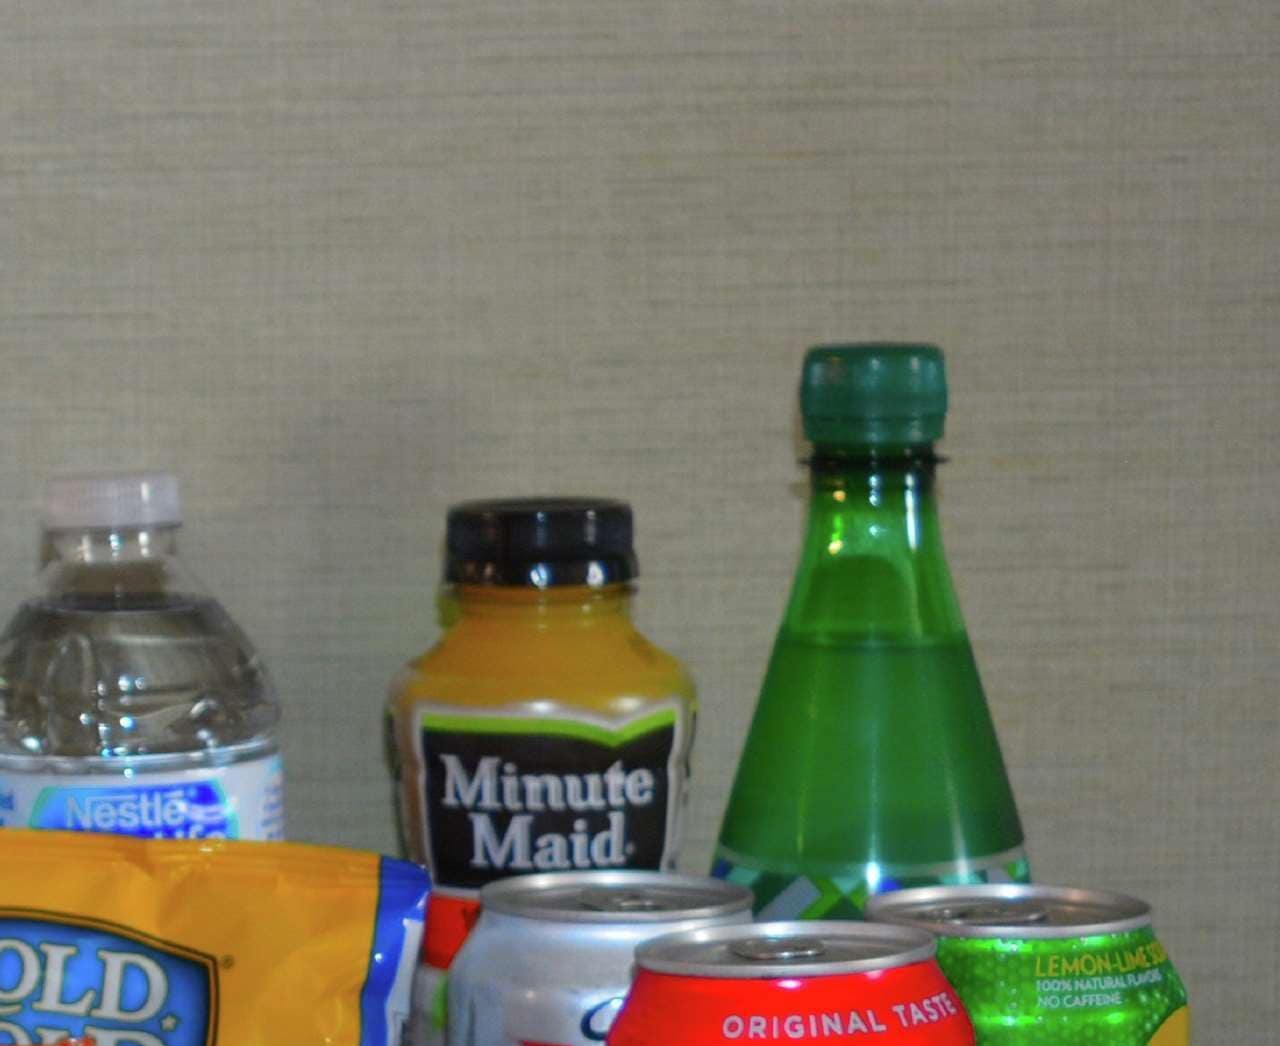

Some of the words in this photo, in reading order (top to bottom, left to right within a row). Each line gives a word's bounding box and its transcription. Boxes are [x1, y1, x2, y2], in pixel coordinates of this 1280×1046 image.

[441, 756, 653, 810] Minute
[67, 790, 188, 828] Nestlé
[469, 812, 626, 869] Maid
[1036, 946, 1147, 977] LEMON-LIME
[1036, 978, 1072, 992] 100%
[1075, 974, 1127, 991] NATURAL
[1038, 996, 1060, 1008] NO
[1064, 992, 1123, 1007] CAFFEINE
[723, 1010, 887, 1038] ORIGINAL
[892, 993, 958, 1027] TASTE
